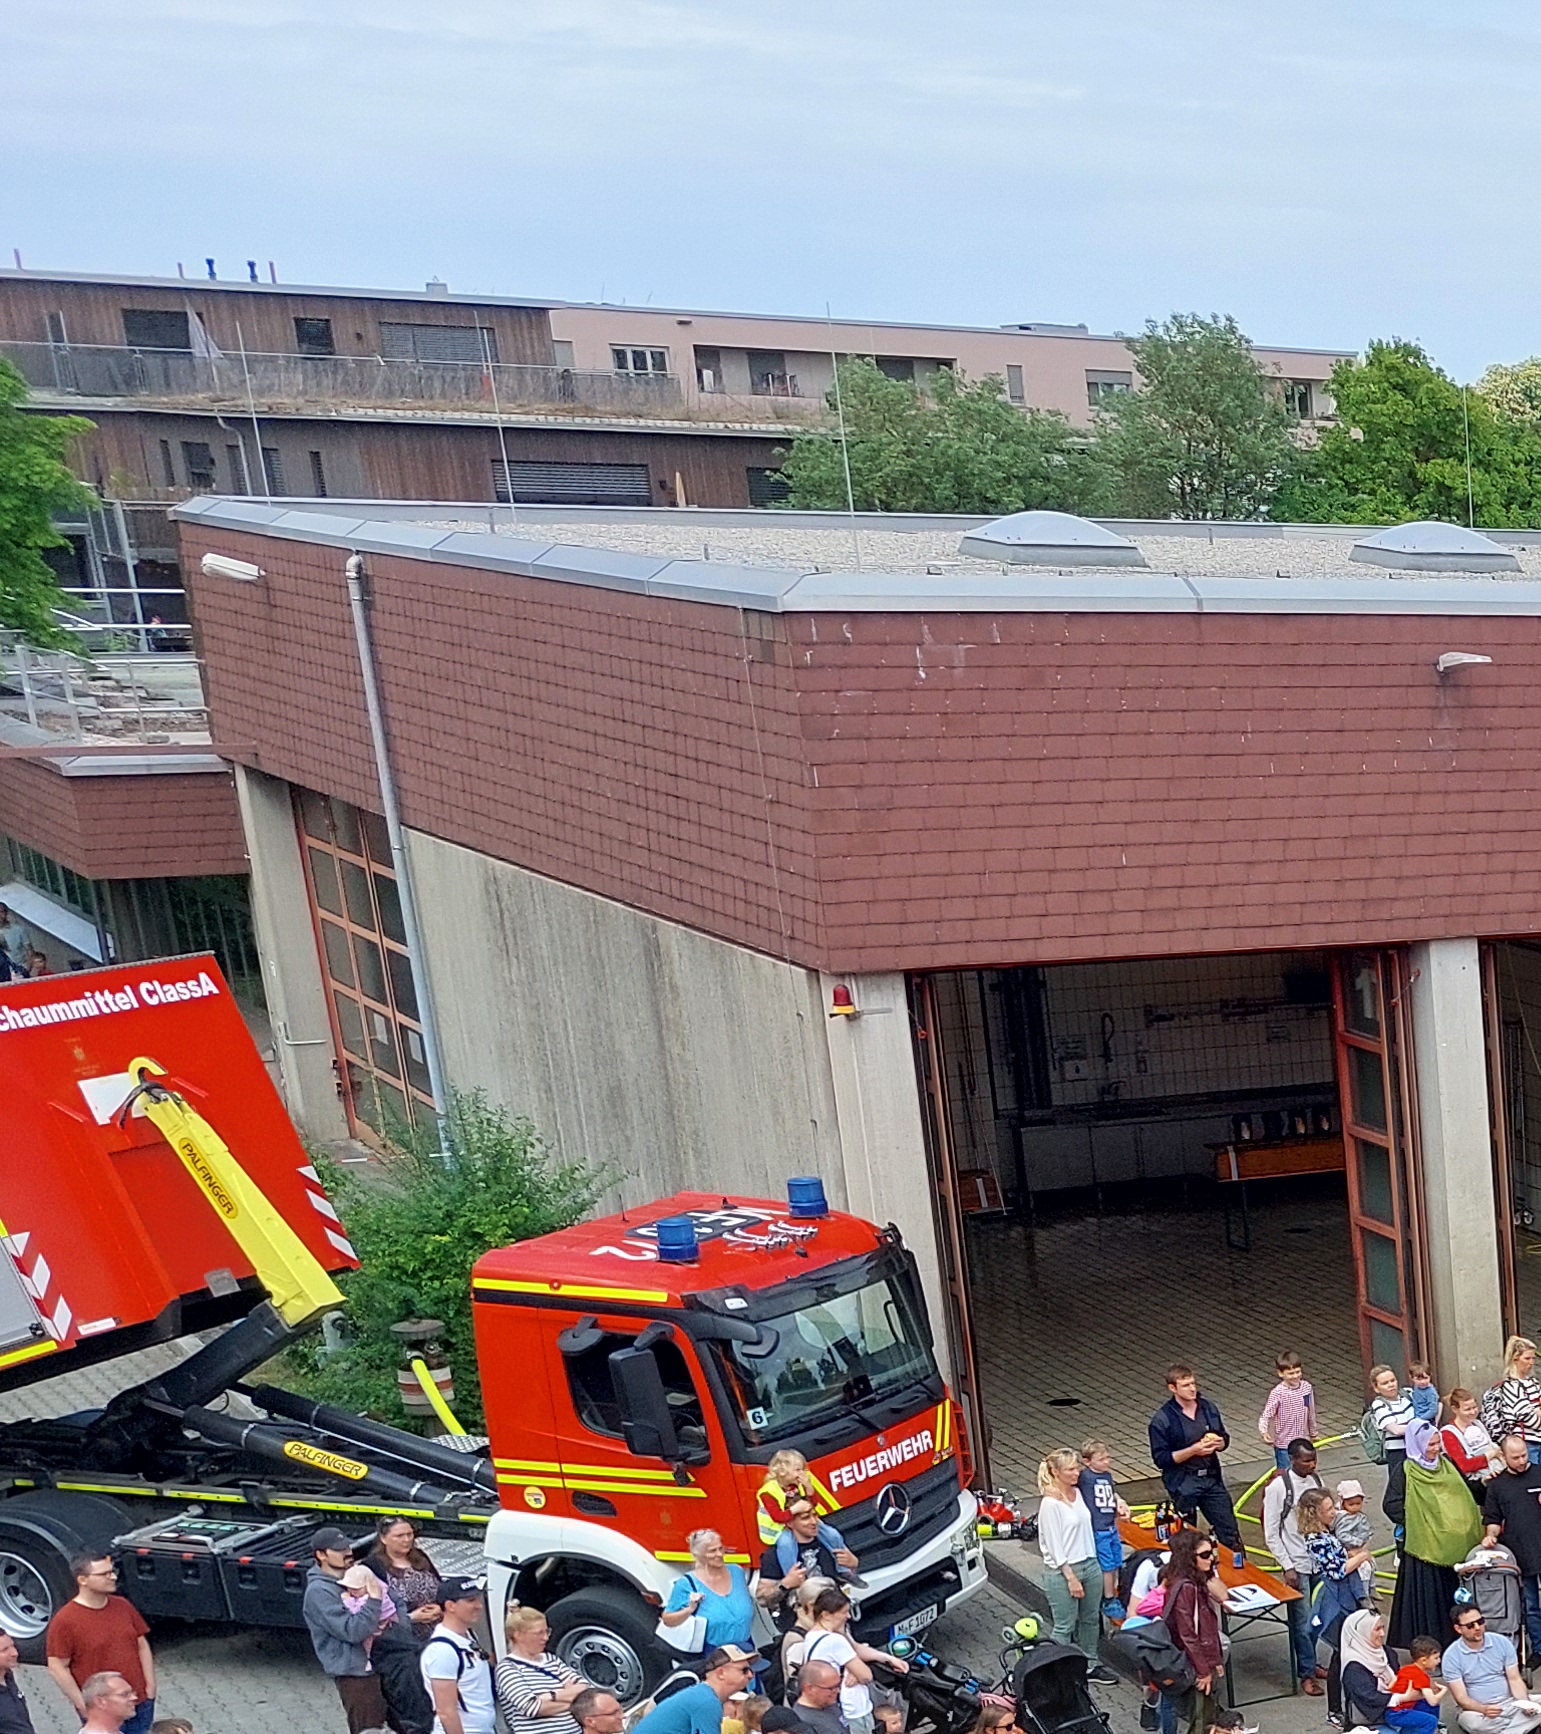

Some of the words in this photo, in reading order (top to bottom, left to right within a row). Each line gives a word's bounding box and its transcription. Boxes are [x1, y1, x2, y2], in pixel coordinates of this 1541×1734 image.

[0, 984, 139, 1032] chaummittel
[139, 971, 220, 1007] ClassA
[181, 1142, 235, 1215] PALFINGER
[751, 1410, 764, 1425] 6
[288, 1443, 363, 1477] PALFINGER
[828, 1429, 934, 1493] FEUERWEHR
[1093, 1484, 1116, 1508] 92
